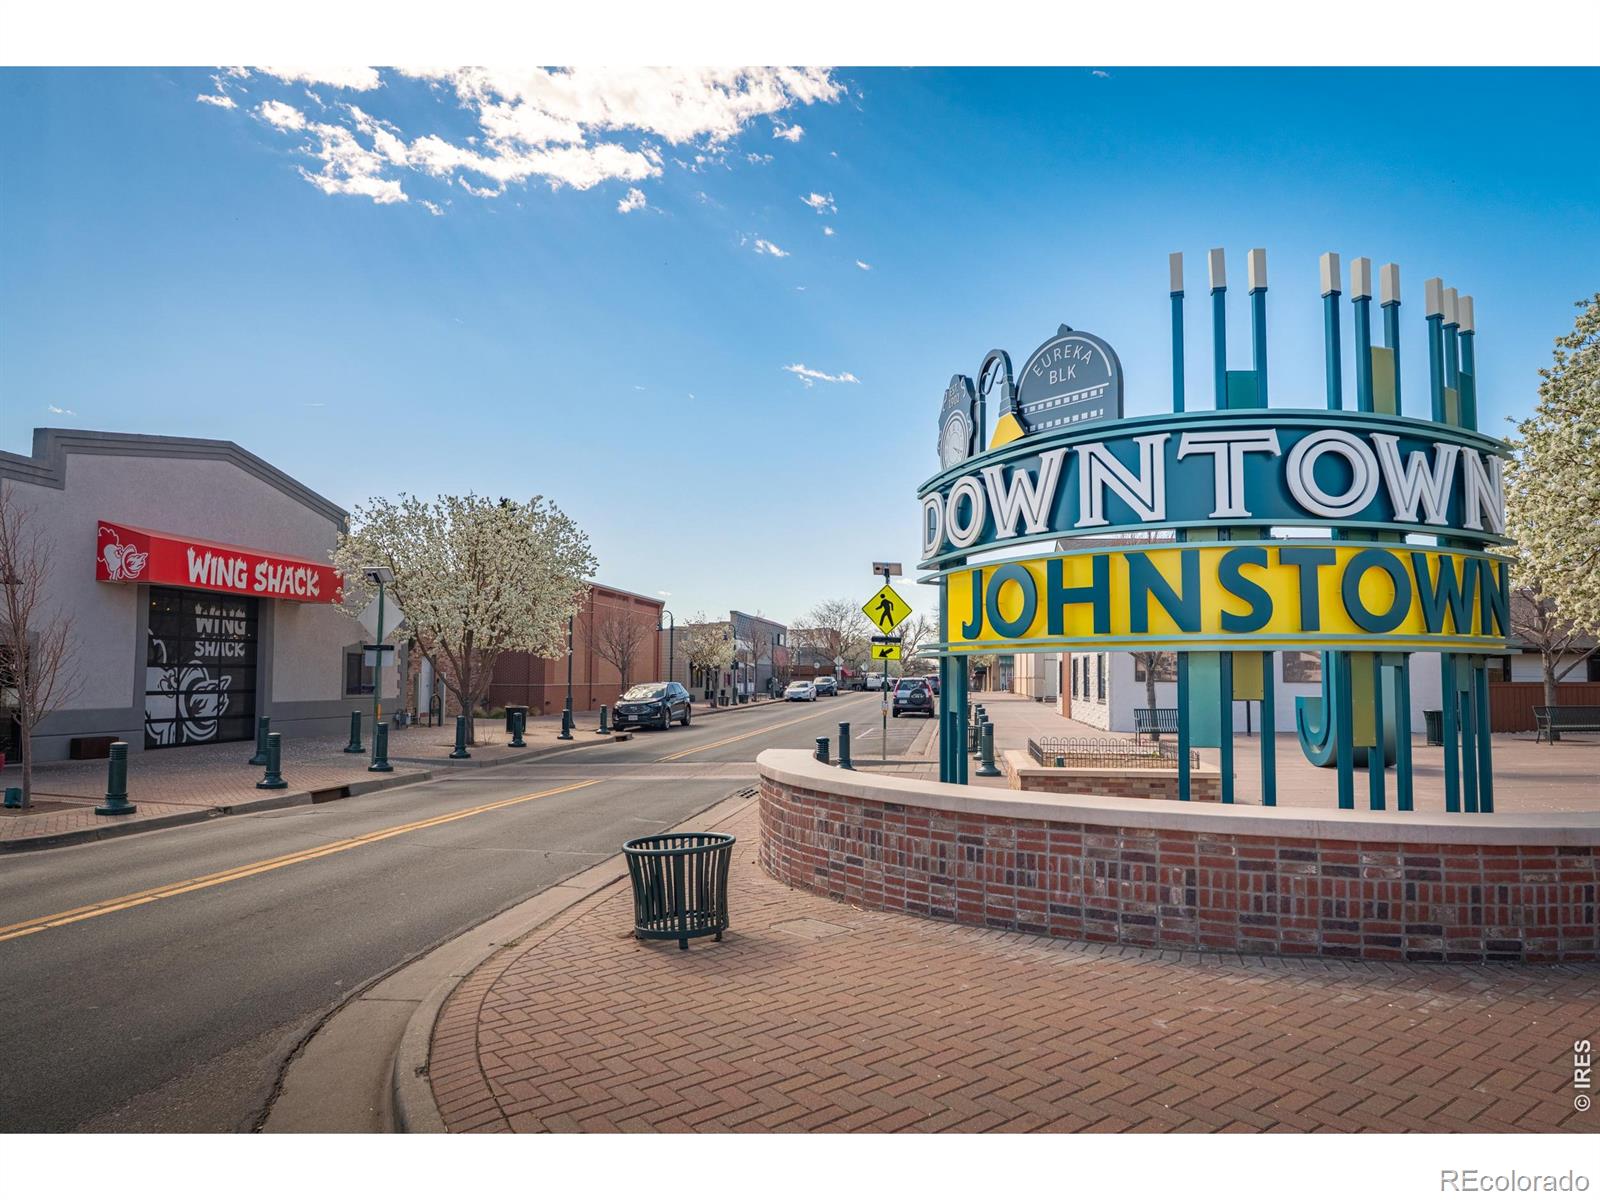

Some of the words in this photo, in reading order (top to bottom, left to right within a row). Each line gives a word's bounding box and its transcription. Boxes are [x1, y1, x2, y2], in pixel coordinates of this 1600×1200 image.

[1032, 344, 1092, 377] EUREKA
[1049, 363, 1076, 385] BLK
[921, 428, 1505, 561] DOWNTOWN
[187, 546, 248, 589] WING
[253, 559, 320, 597] SHACK
[962, 547, 1510, 641] JOHNSTOWN
[194, 603, 247, 635] WING
[193, 634, 246, 657] SHACK
